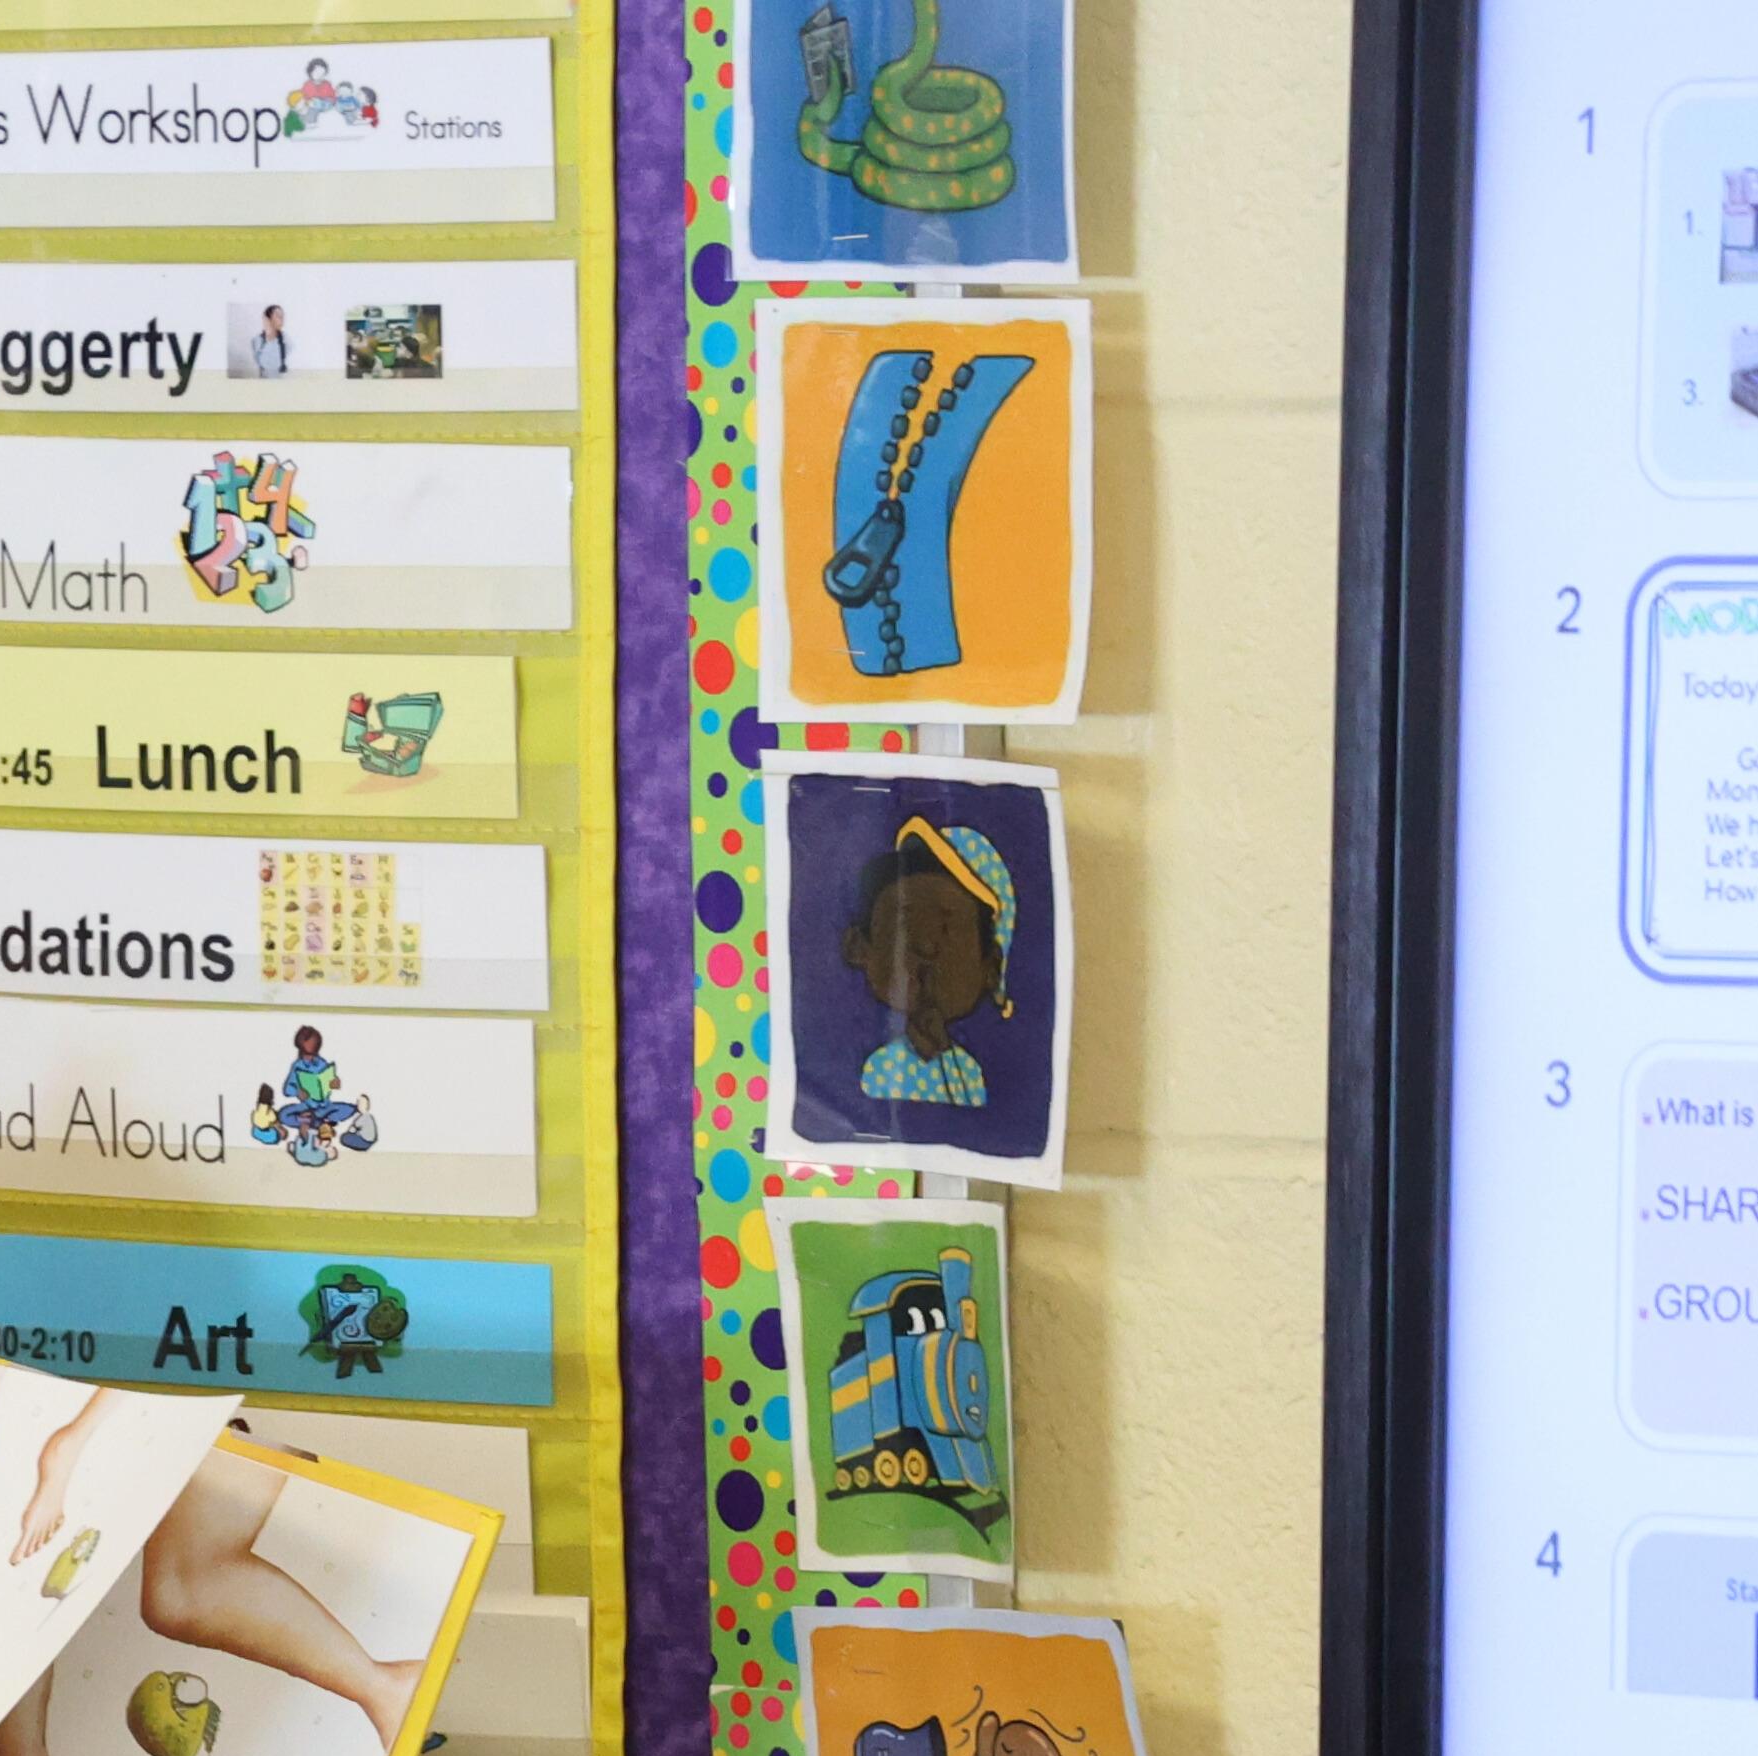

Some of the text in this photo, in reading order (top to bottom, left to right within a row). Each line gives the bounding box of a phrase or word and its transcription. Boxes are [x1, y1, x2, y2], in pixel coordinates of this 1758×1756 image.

[26, 82, 283, 168] Workshop
[404, 110, 504, 143] Stations
[1576, 105, 1596, 156] 1
[1555, 584, 1583, 635] 2
[95, 725, 304, 795] Lunch
[1544, 1058, 1573, 1109] 3
[60, 1084, 227, 1164] Aloud
[1656, 1097, 1755, 1129] What is
[152, 1305, 255, 1376] Art
[1535, 1529, 1564, 1579] 4
